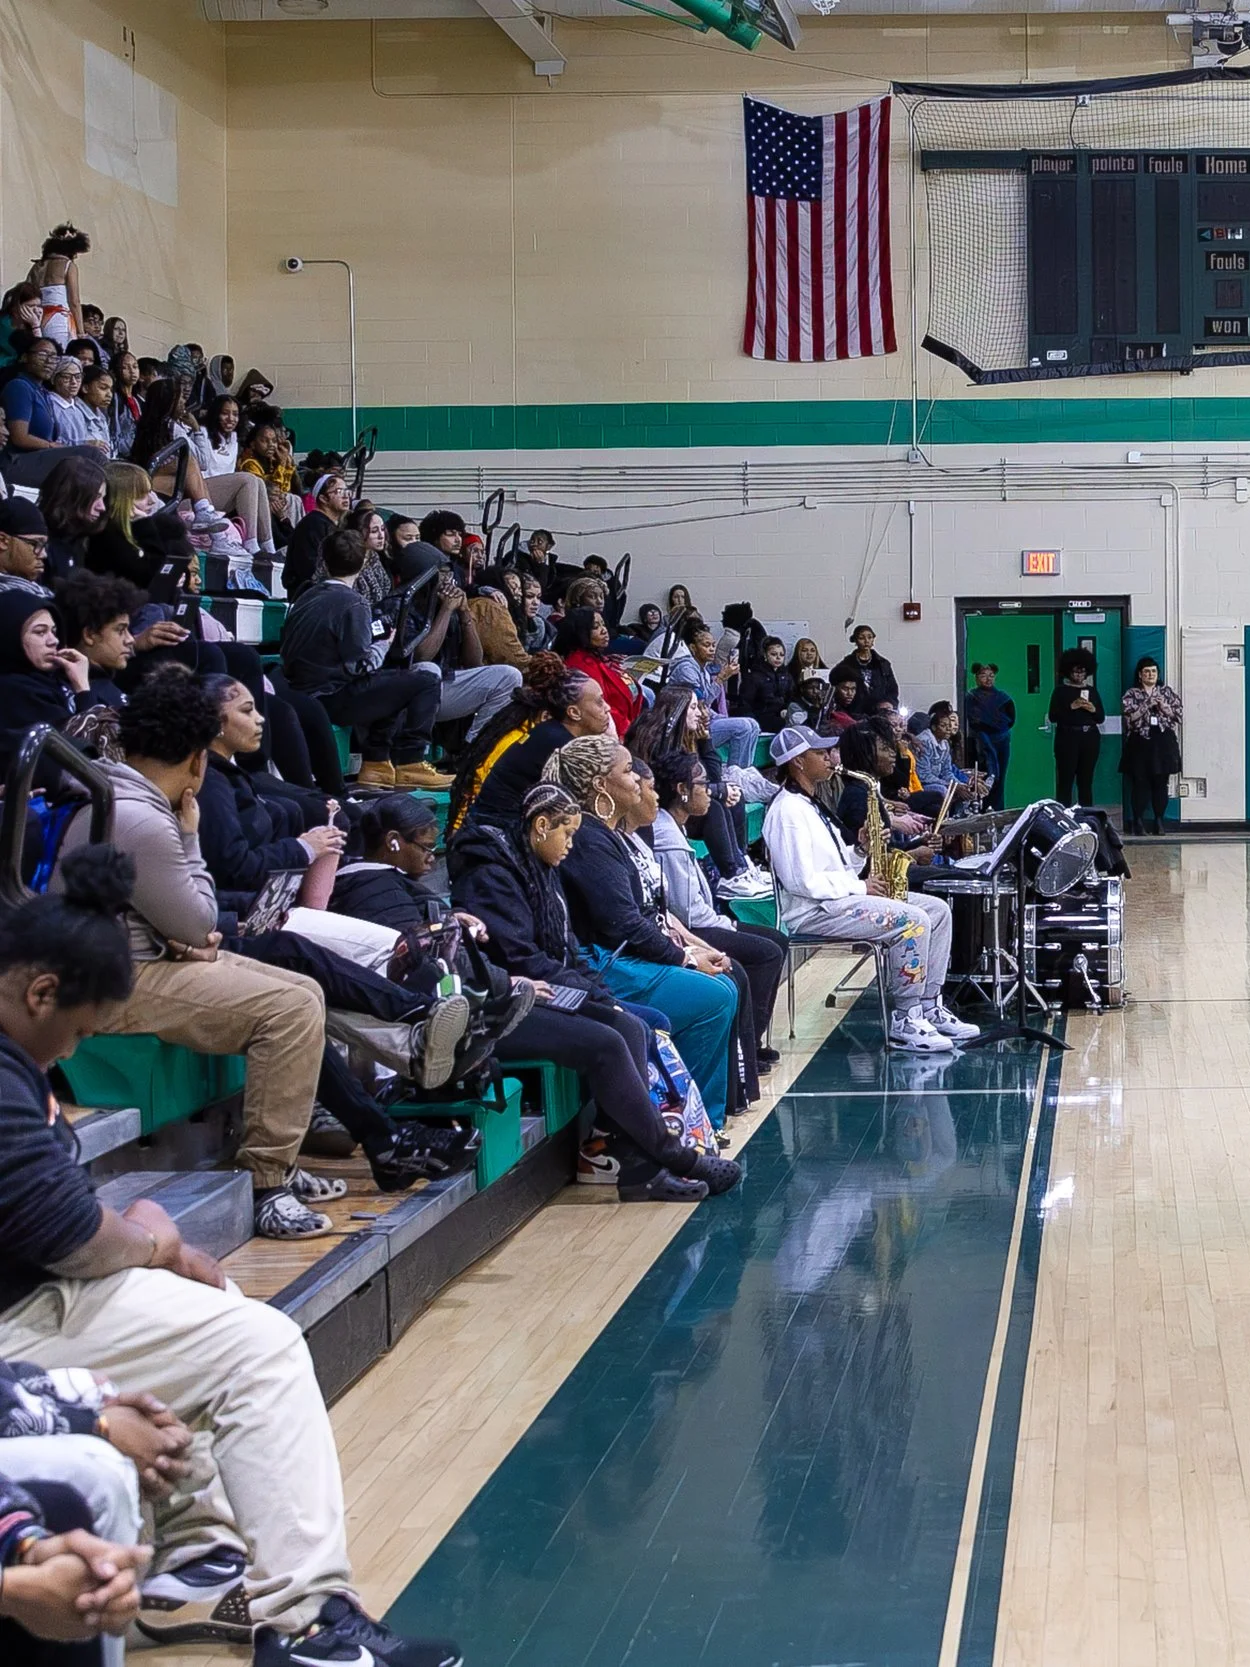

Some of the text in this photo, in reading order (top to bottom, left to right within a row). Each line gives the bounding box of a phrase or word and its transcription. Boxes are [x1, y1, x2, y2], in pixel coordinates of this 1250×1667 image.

[1031, 155, 1074, 173] player
[1092, 155, 1135, 173] points
[1149, 155, 1183, 173] fouls
[1205, 156, 1247, 174] Home
[1210, 253, 1245, 270] fouls
[1212, 320, 1241, 334] won
[1029, 552, 1056, 573] EXIT
